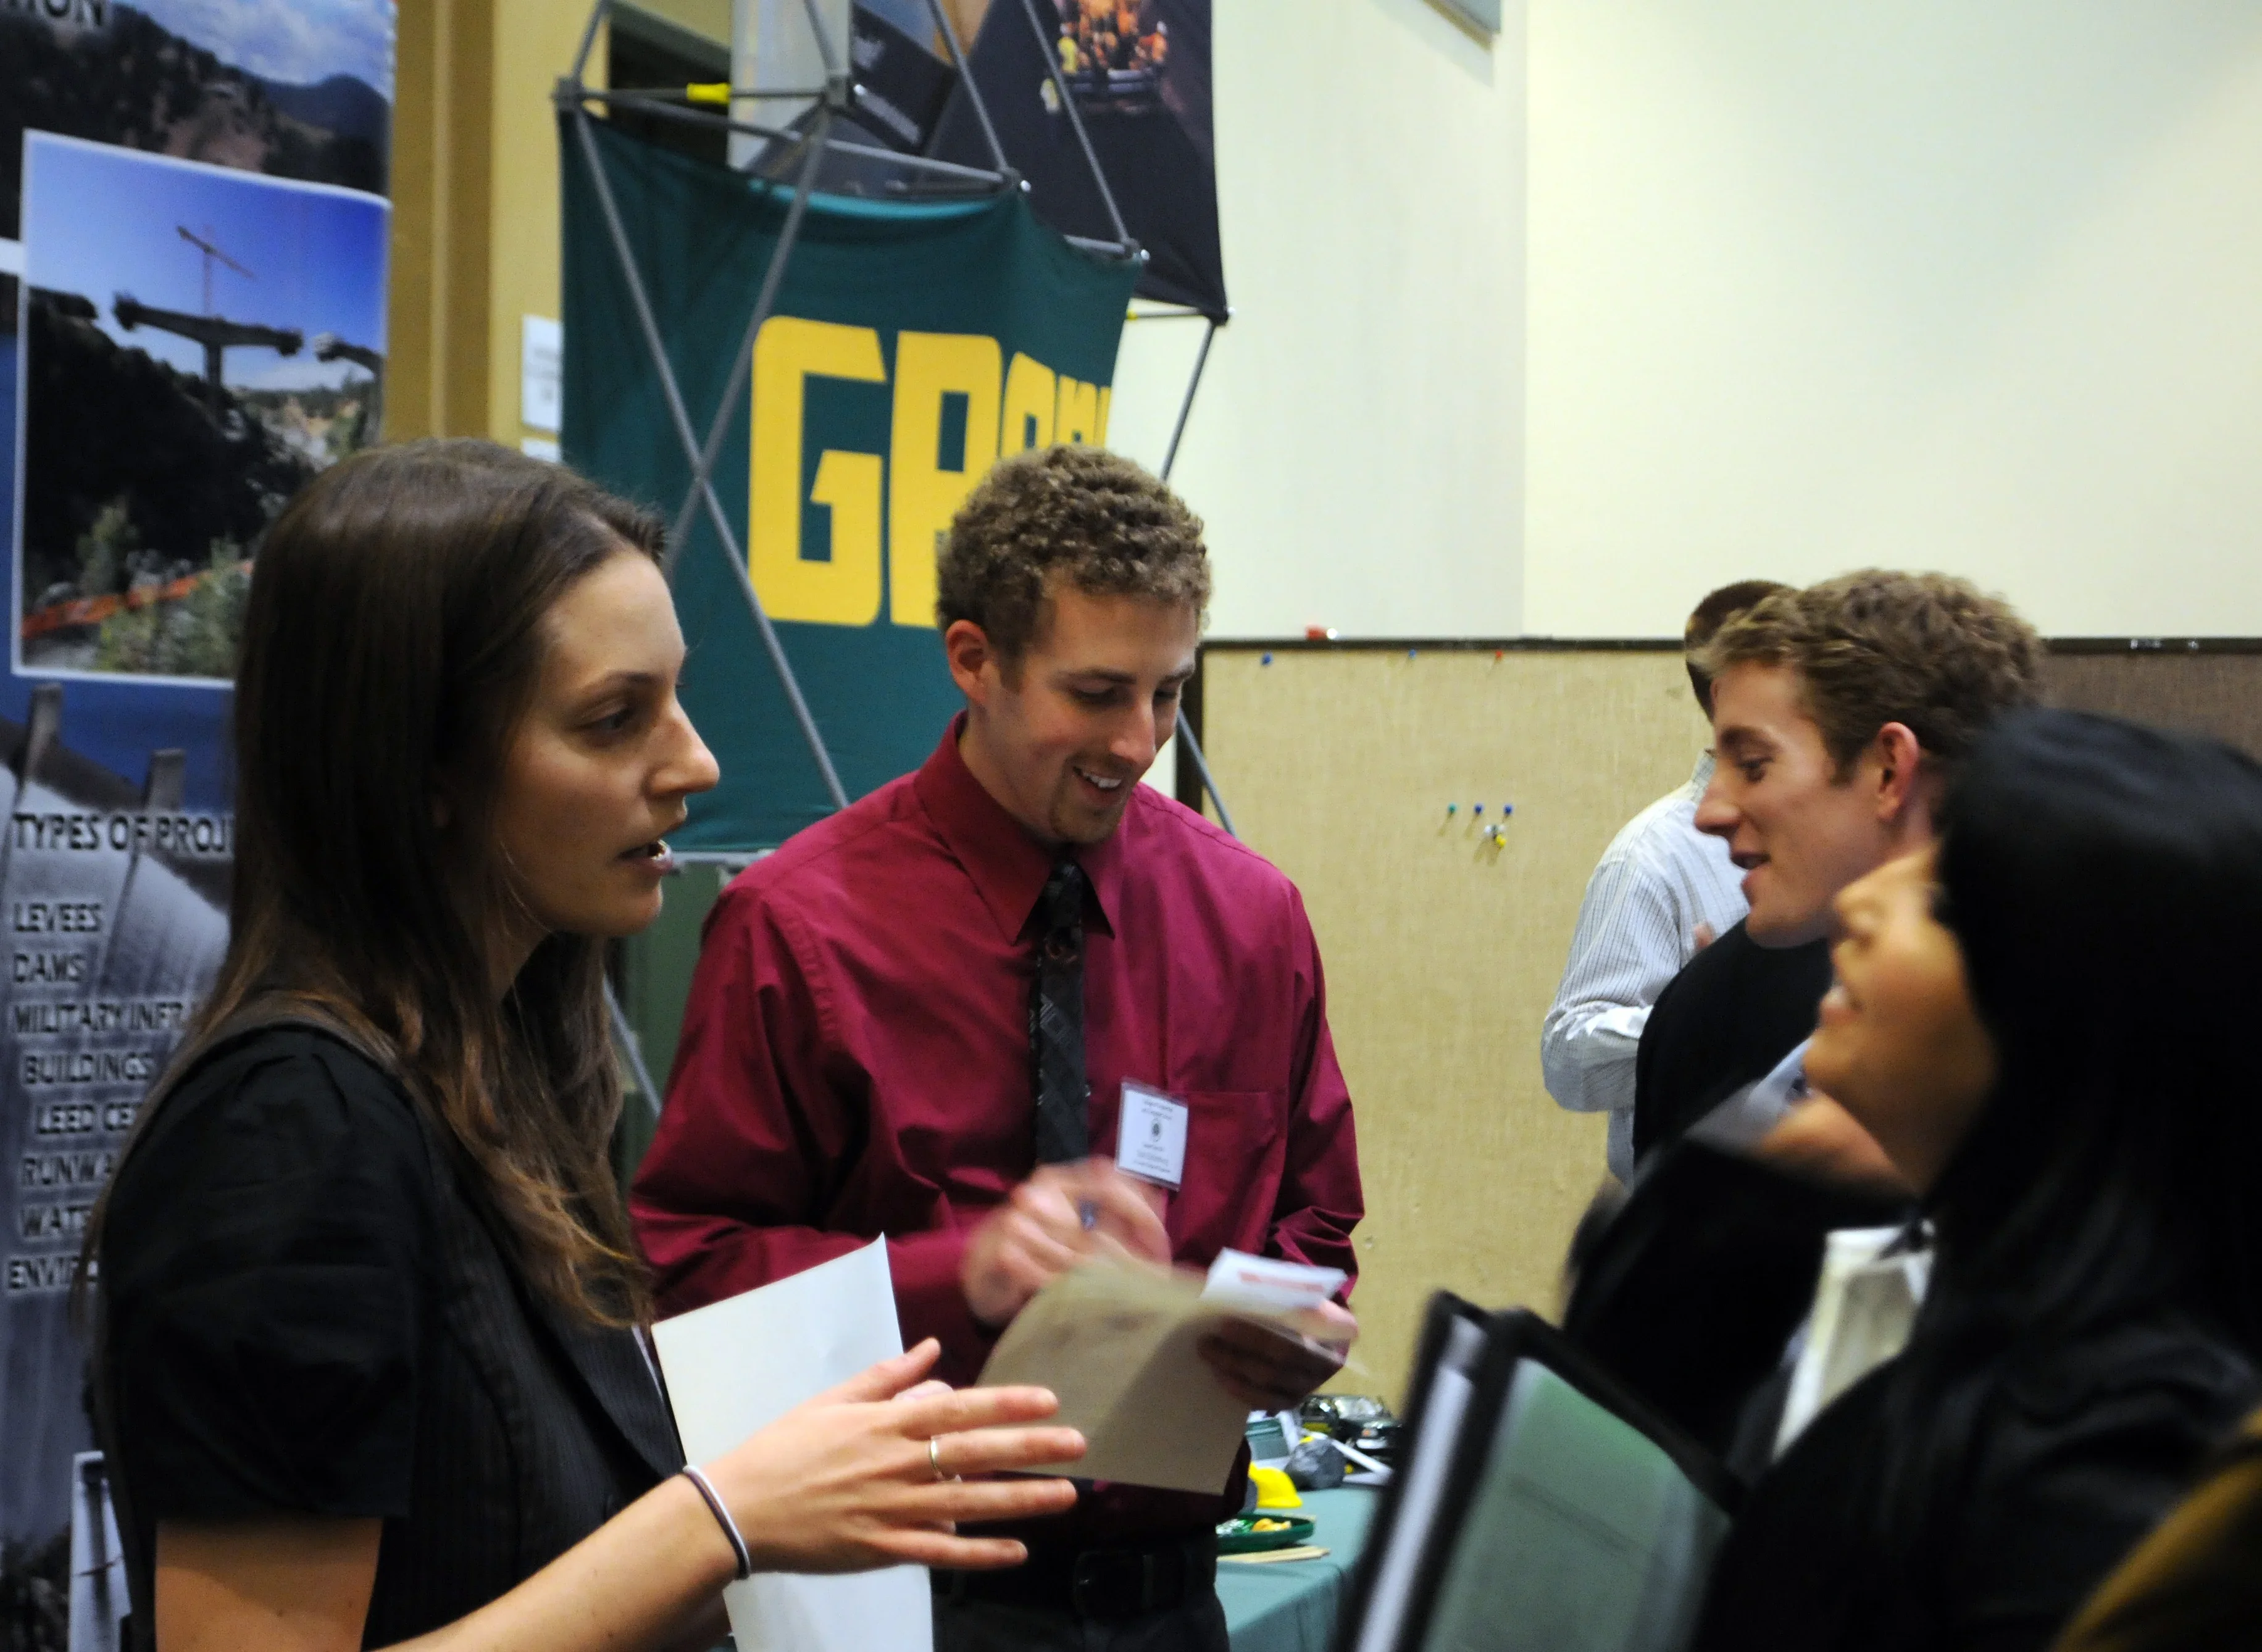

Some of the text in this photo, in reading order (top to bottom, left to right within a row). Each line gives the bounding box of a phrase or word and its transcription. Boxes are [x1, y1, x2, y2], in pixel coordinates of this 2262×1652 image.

[12, 812, 101, 850] TYPES
[111, 815, 149, 851] OF
[14, 903, 102, 932] LEVEES
[14, 954, 85, 983] DAMS
[15, 1003, 123, 1033] MILITARY
[27, 1052, 154, 1083] BUILDINGS
[37, 1104, 94, 1134] LEED
